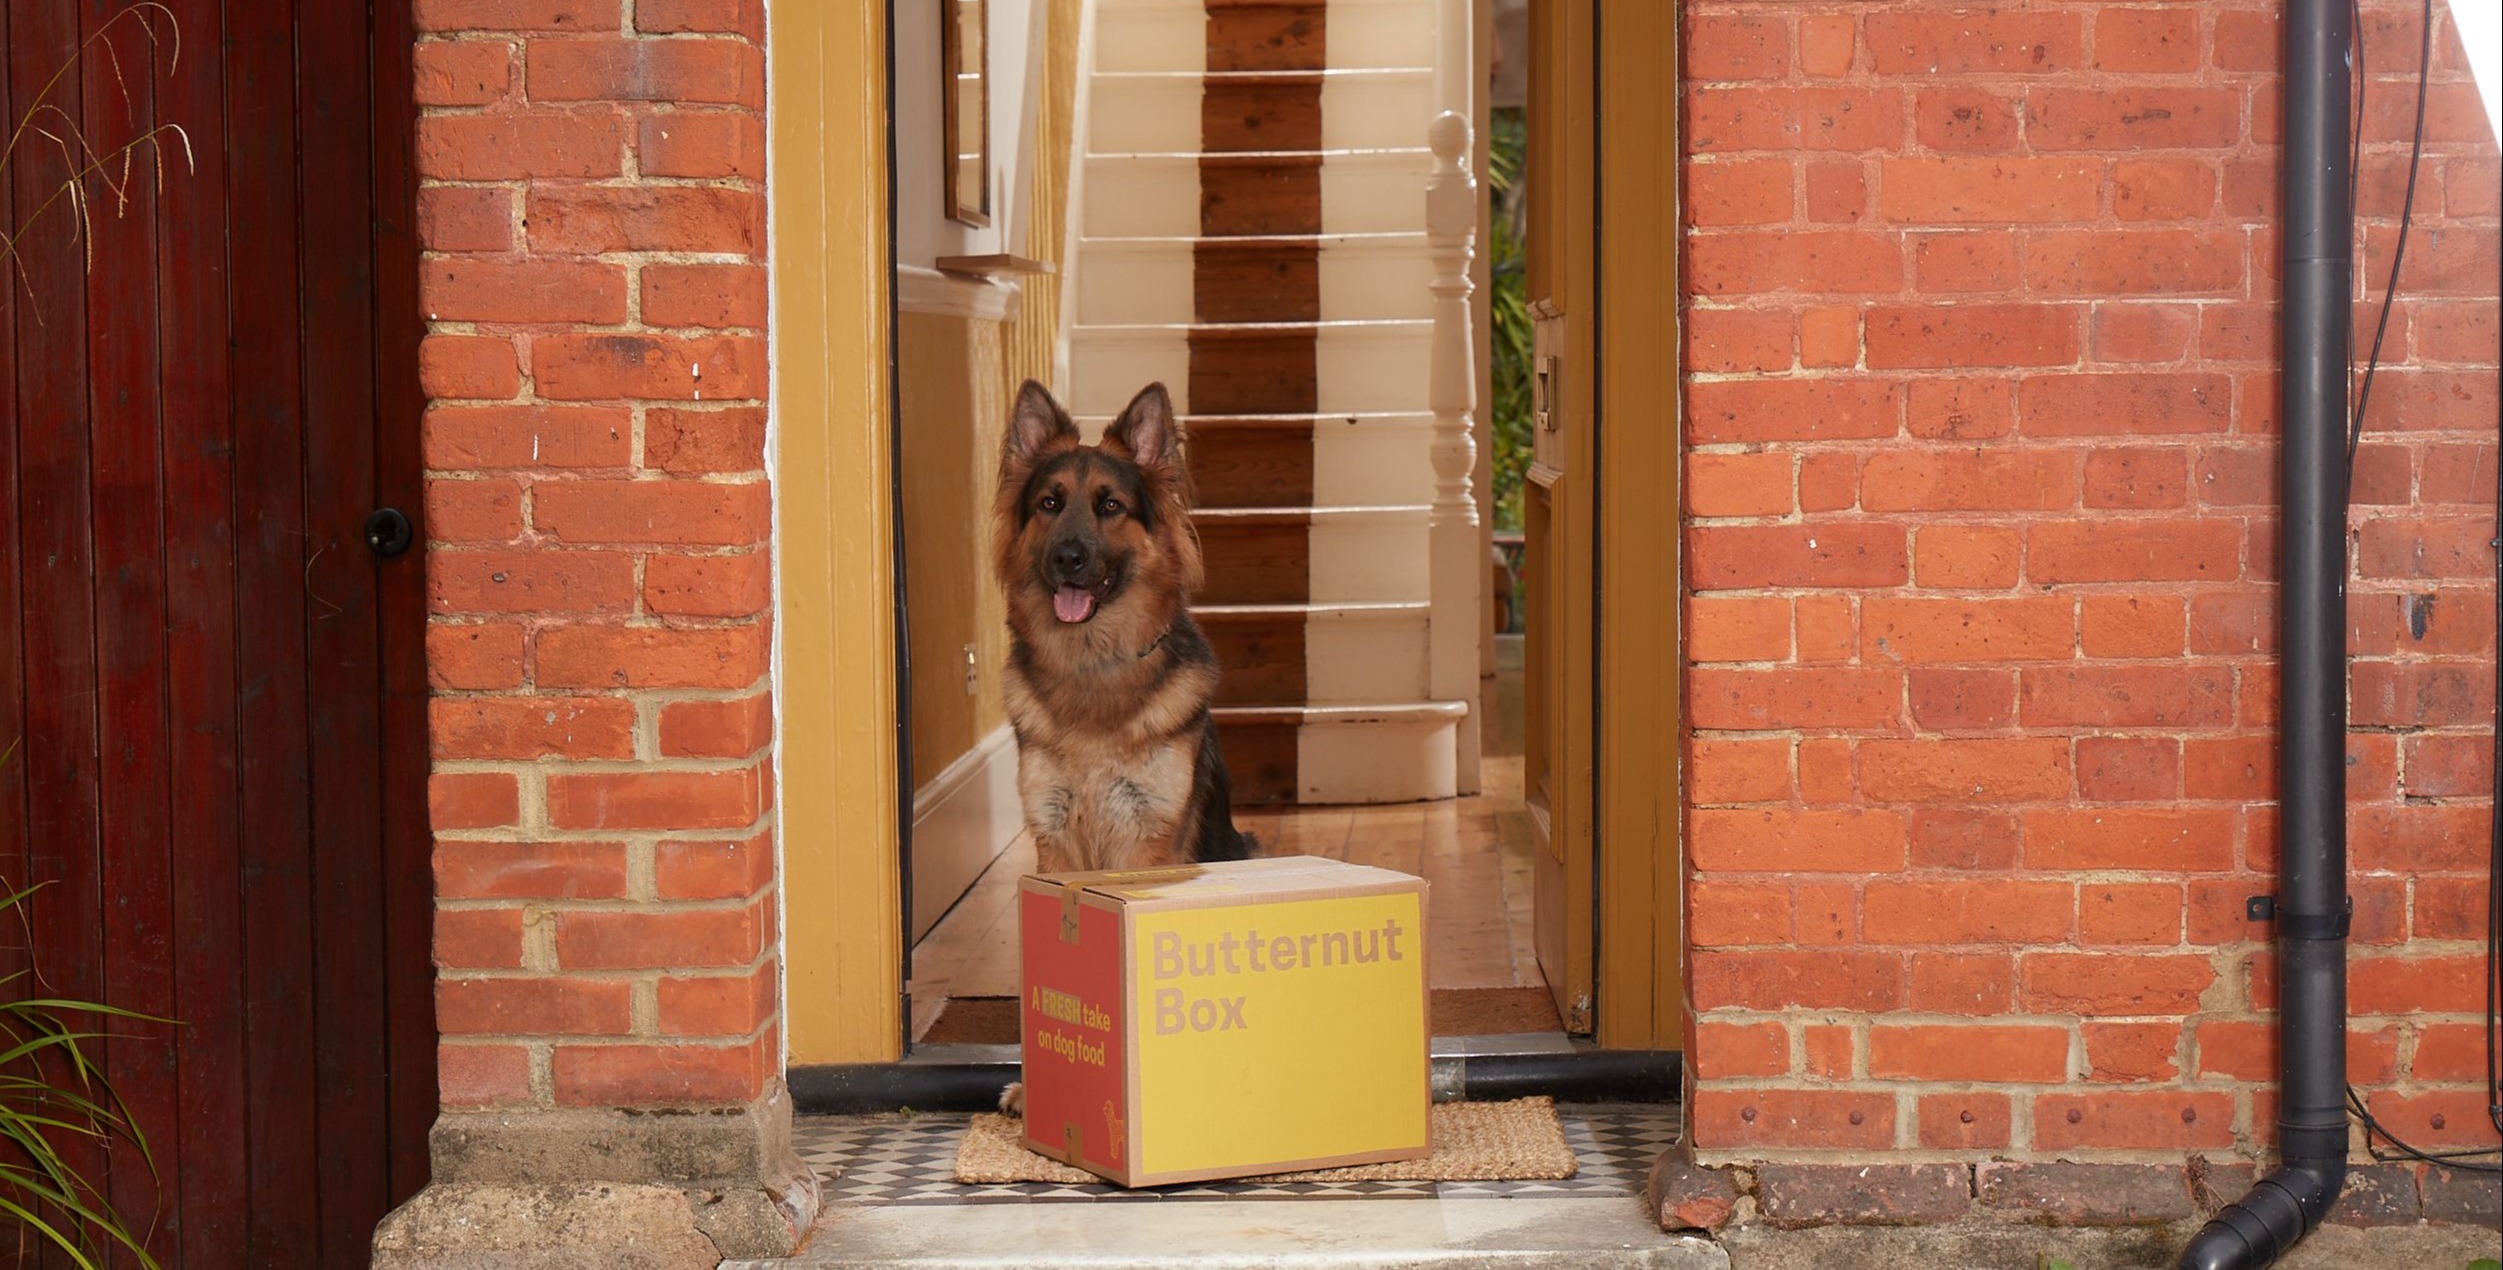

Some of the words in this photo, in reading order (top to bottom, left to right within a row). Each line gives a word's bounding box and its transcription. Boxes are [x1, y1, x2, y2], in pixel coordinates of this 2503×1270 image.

[1153, 919, 1403, 980] Butternut
[1031, 985, 1040, 1011] A
[1042, 988, 1081, 1025] FRESH
[1083, 1003, 1111, 1032] take
[1155, 987, 1247, 1036] Box
[1038, 1029, 1052, 1050] on
[1054, 1028, 1075, 1063] dog
[1077, 1034, 1105, 1067] food
